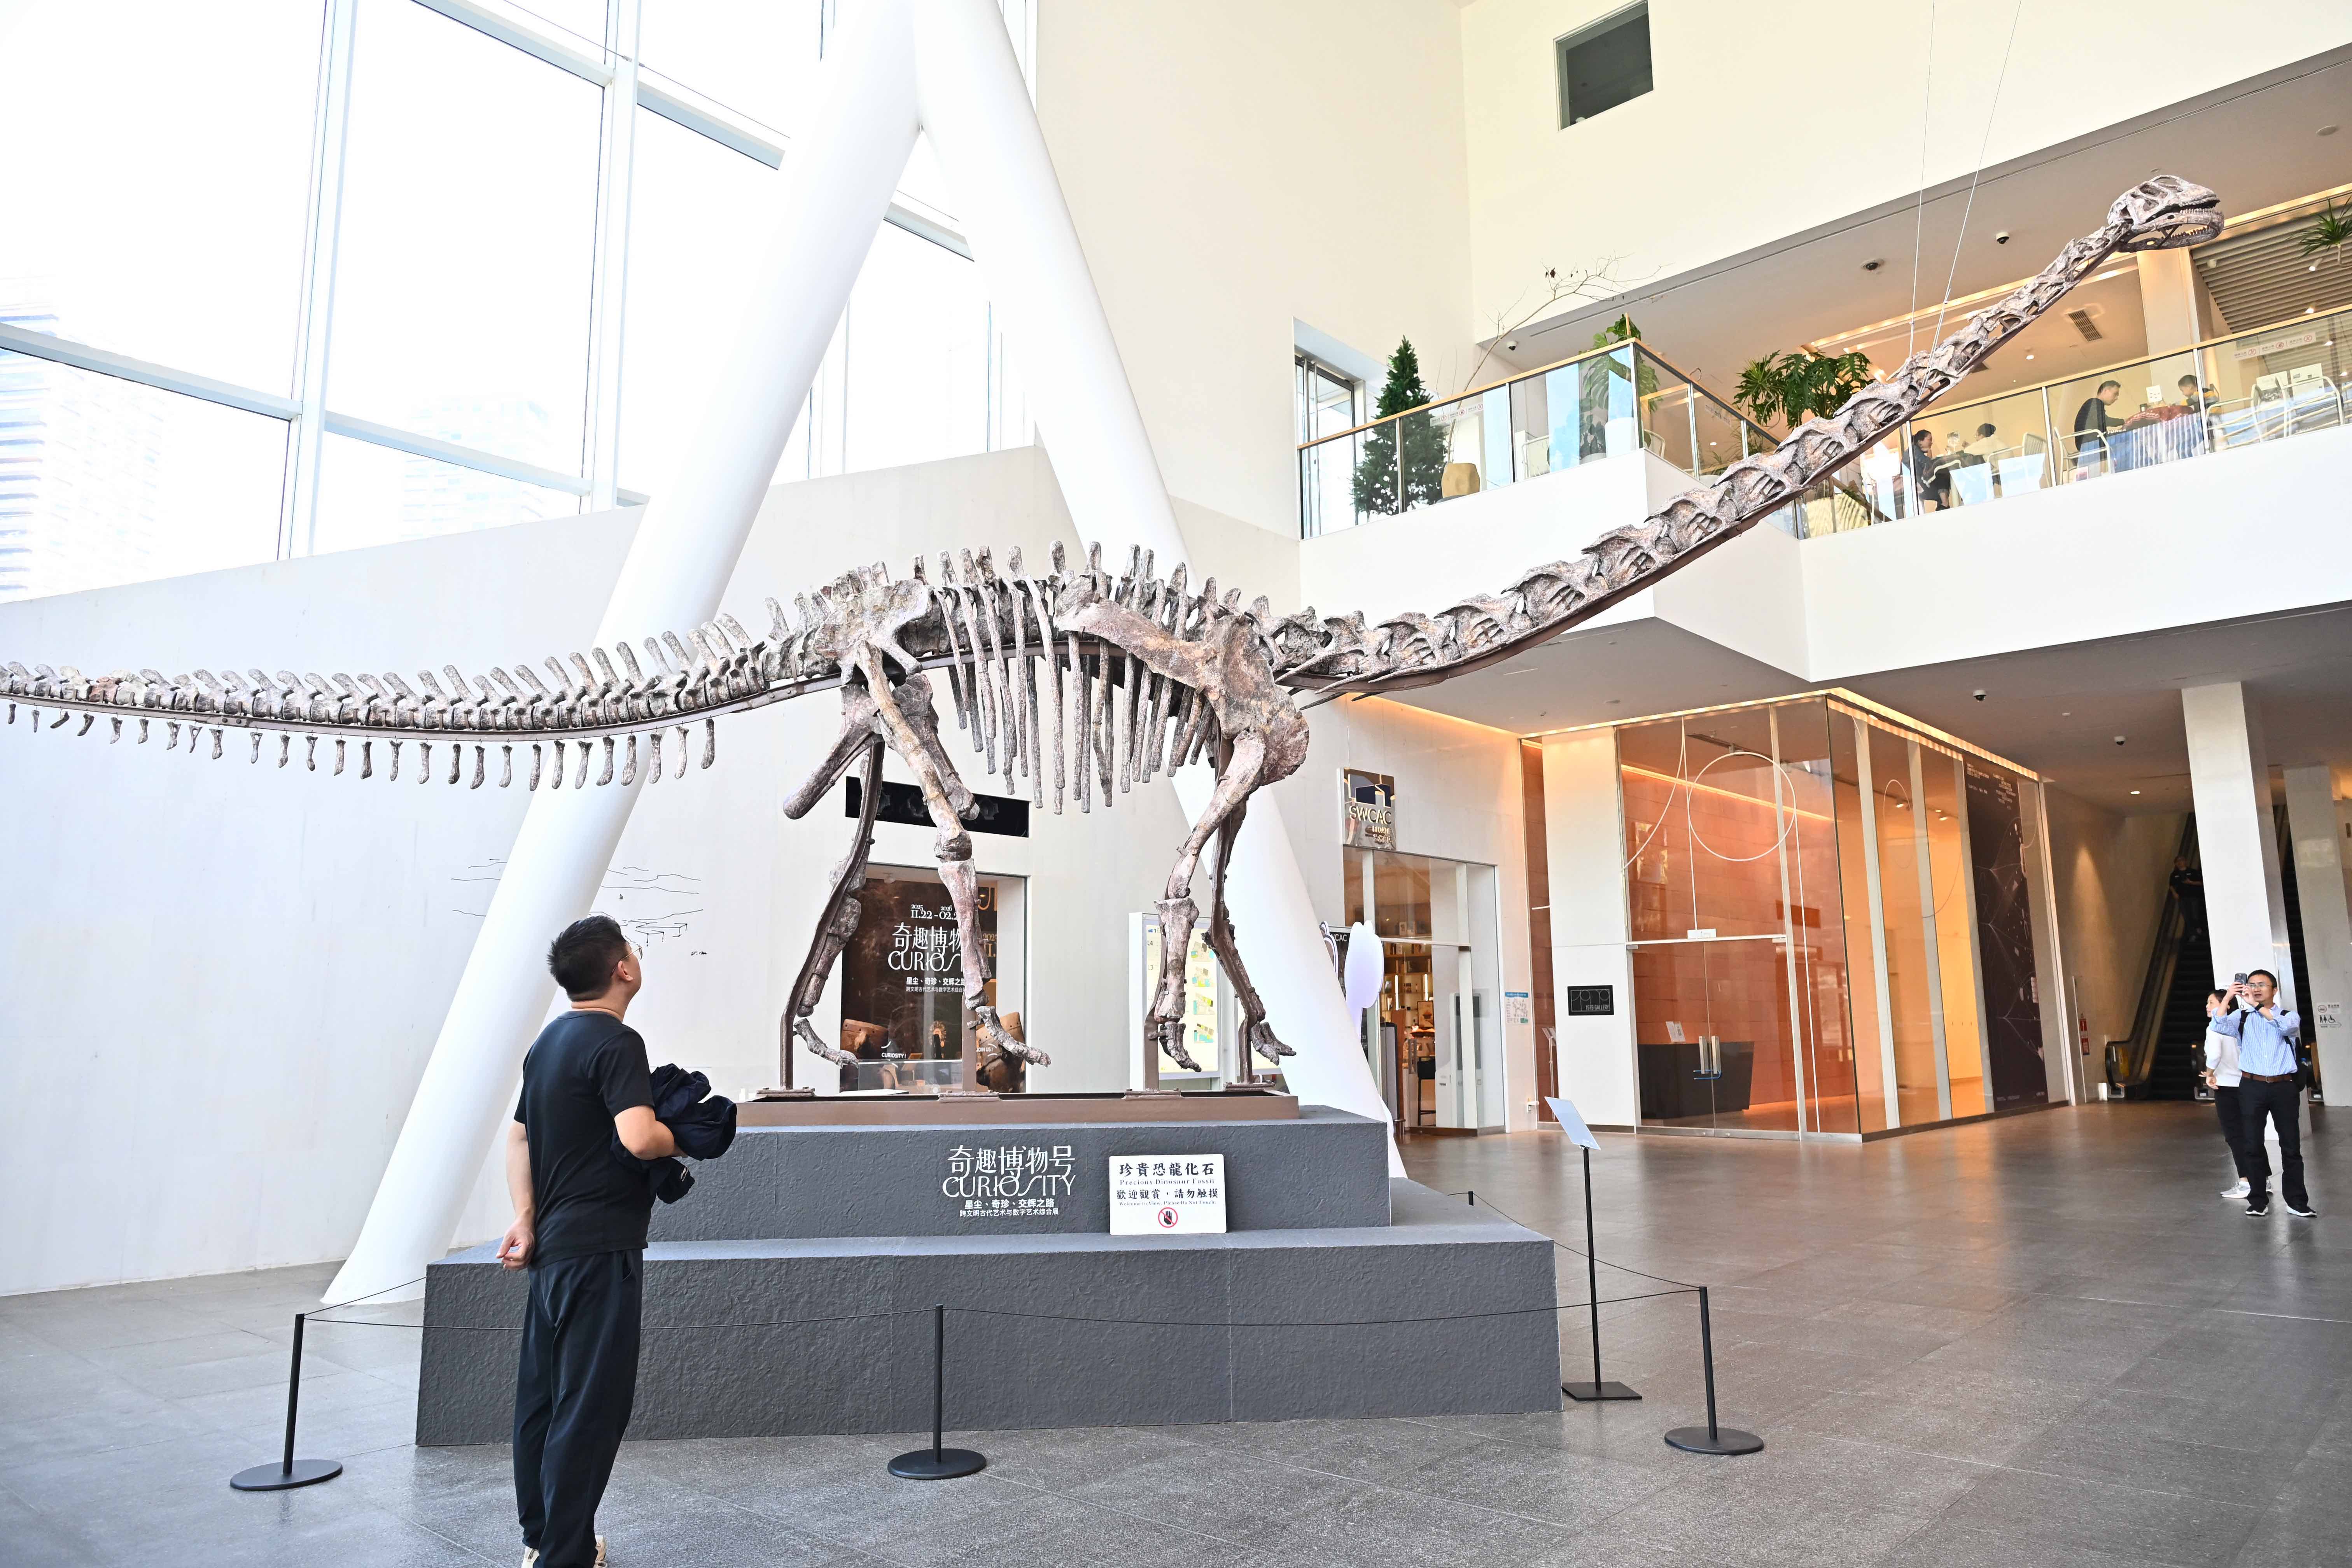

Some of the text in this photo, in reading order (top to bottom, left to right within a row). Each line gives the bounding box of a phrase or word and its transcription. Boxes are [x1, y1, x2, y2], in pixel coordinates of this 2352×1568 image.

[1349, 805, 1391, 824] SWCAC
[939, 911, 958, 920] 02.2
[892, 922, 961, 954] 奇趣博物
[1331, 933, 1348, 942] CAC
[888, 950, 963, 972] CURIOSI
[948, 1144, 1076, 1178] 奇趣博物号
[1119, 1162, 1214, 1177] 珍貴恐龍化石
[942, 1175, 1076, 1197] CURIOSITY
[964, 1198, 1055, 1209] 星尘、奇珍、交辉之路
[960, 1208, 1059, 1217] 跨文明古代艺术与数字艺术综合展
